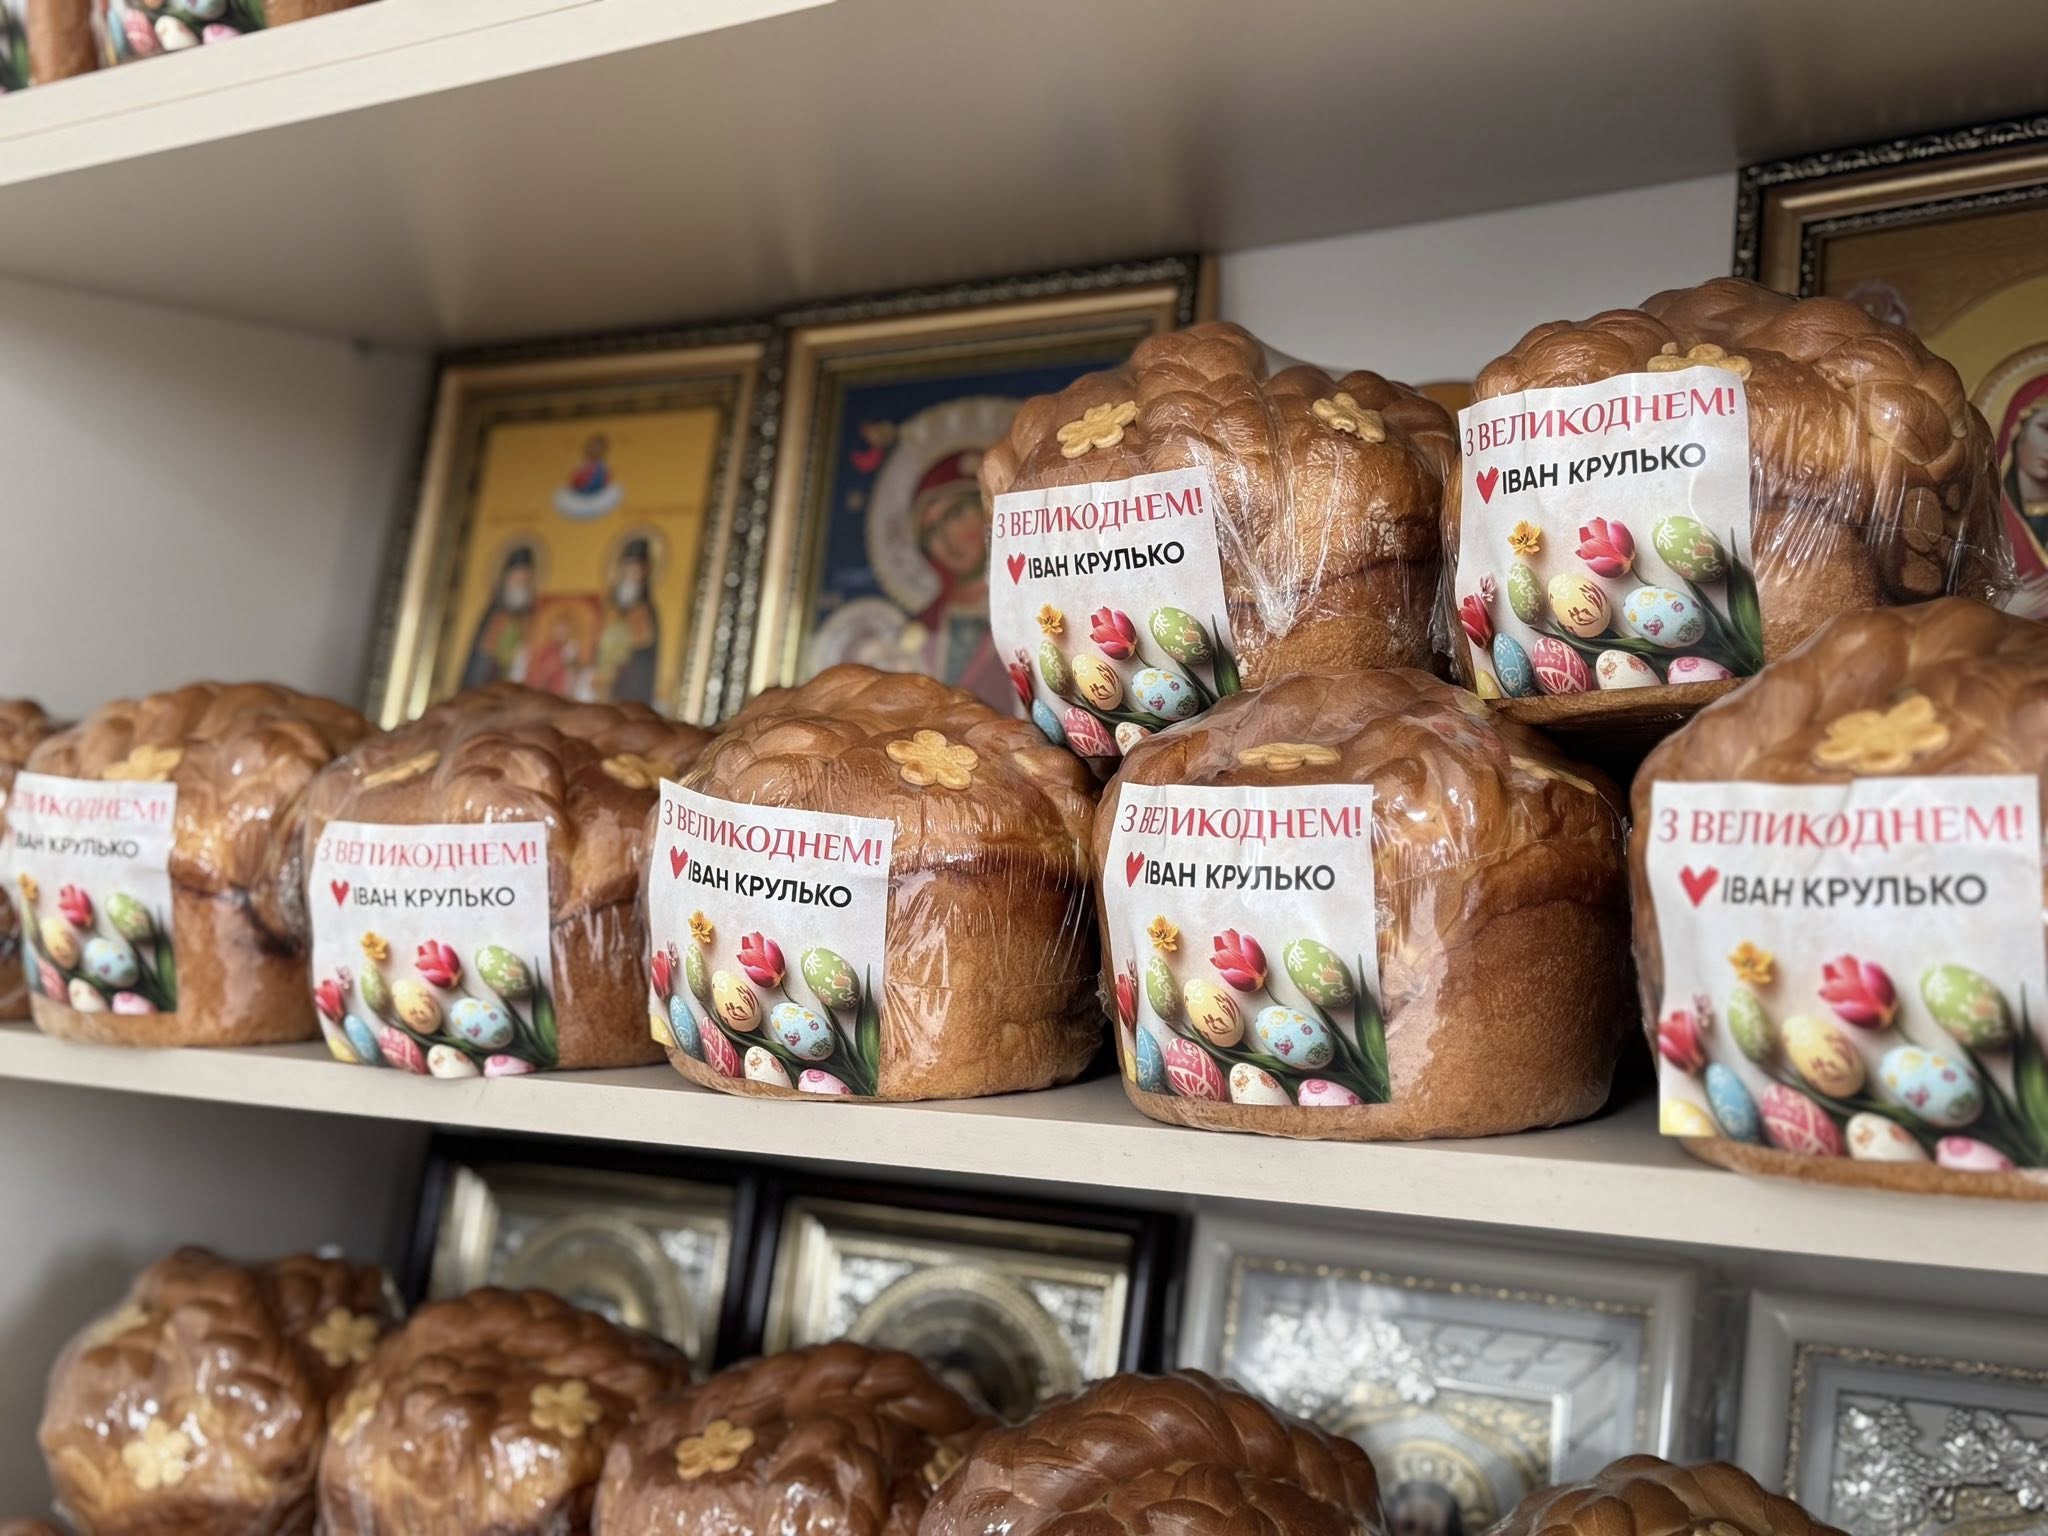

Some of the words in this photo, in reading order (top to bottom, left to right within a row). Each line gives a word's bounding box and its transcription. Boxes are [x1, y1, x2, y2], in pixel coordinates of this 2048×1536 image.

[1465, 427, 1475, 457] З
[1477, 387, 1736, 451] ВЕЛИКОДНЕМ!
[1502, 463, 1558, 495] ІВАН
[1569, 442, 1706, 485] КРУЛЬКО
[995, 512, 1006, 539] З
[1010, 487, 1204, 537] ВЕЛИКОДНЕМ!
[1028, 554, 1068, 579] ІВАН
[1074, 540, 1185, 576] КРУЛЬКО
[663, 799, 673, 826] З
[677, 803, 883, 867] ВЕЛИКОДНЕМ!
[1120, 803, 1138, 833] З
[1138, 806, 1362, 846] ВЕЛИКОДНЕМ!
[1657, 807, 1678, 843] З
[1691, 804, 2024, 854] ВЕЛИКОДНЕМ!
[319, 838, 332, 862] З
[335, 840, 538, 871] ВЕЛИКОДНЕМ!
[1144, 859, 1196, 888] ІВАН
[1206, 863, 1335, 891] КРУЛЬКО
[352, 887, 397, 907] ІВАН
[404, 886, 516, 908] КРУЛЬКО
[688, 858, 729, 891] ІВАН
[735, 872, 852, 908] КРУЛЬКО
[1722, 875, 1794, 907] ІВАН
[1803, 873, 1987, 908] КРУЛЬКО
